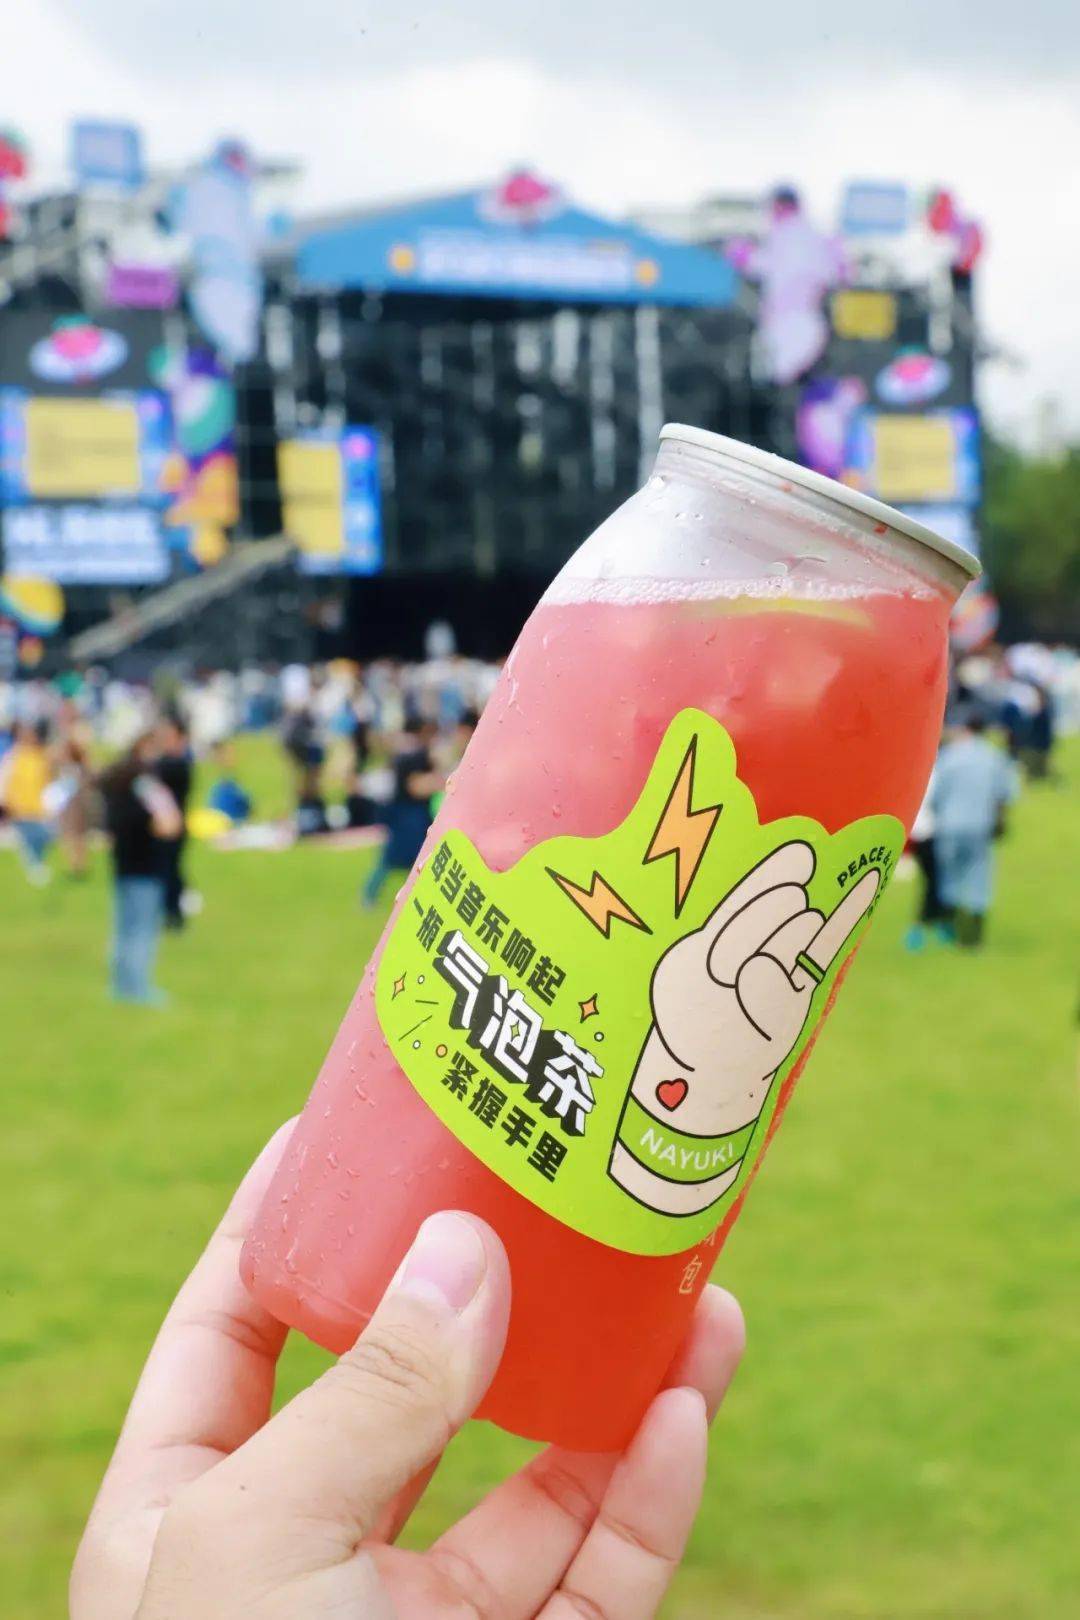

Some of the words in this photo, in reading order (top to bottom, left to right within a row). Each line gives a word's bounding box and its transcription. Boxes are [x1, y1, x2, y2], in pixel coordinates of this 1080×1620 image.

[431, 840, 567, 1006] 每当音乐响起
[836, 846, 885, 888] PEACE
[413, 897, 444, 953] 一瓶
[433, 929, 605, 1136] 气泡茶
[441, 1050, 568, 1183] 紧握手里
[640, 1127, 733, 1170] NAYUKI
